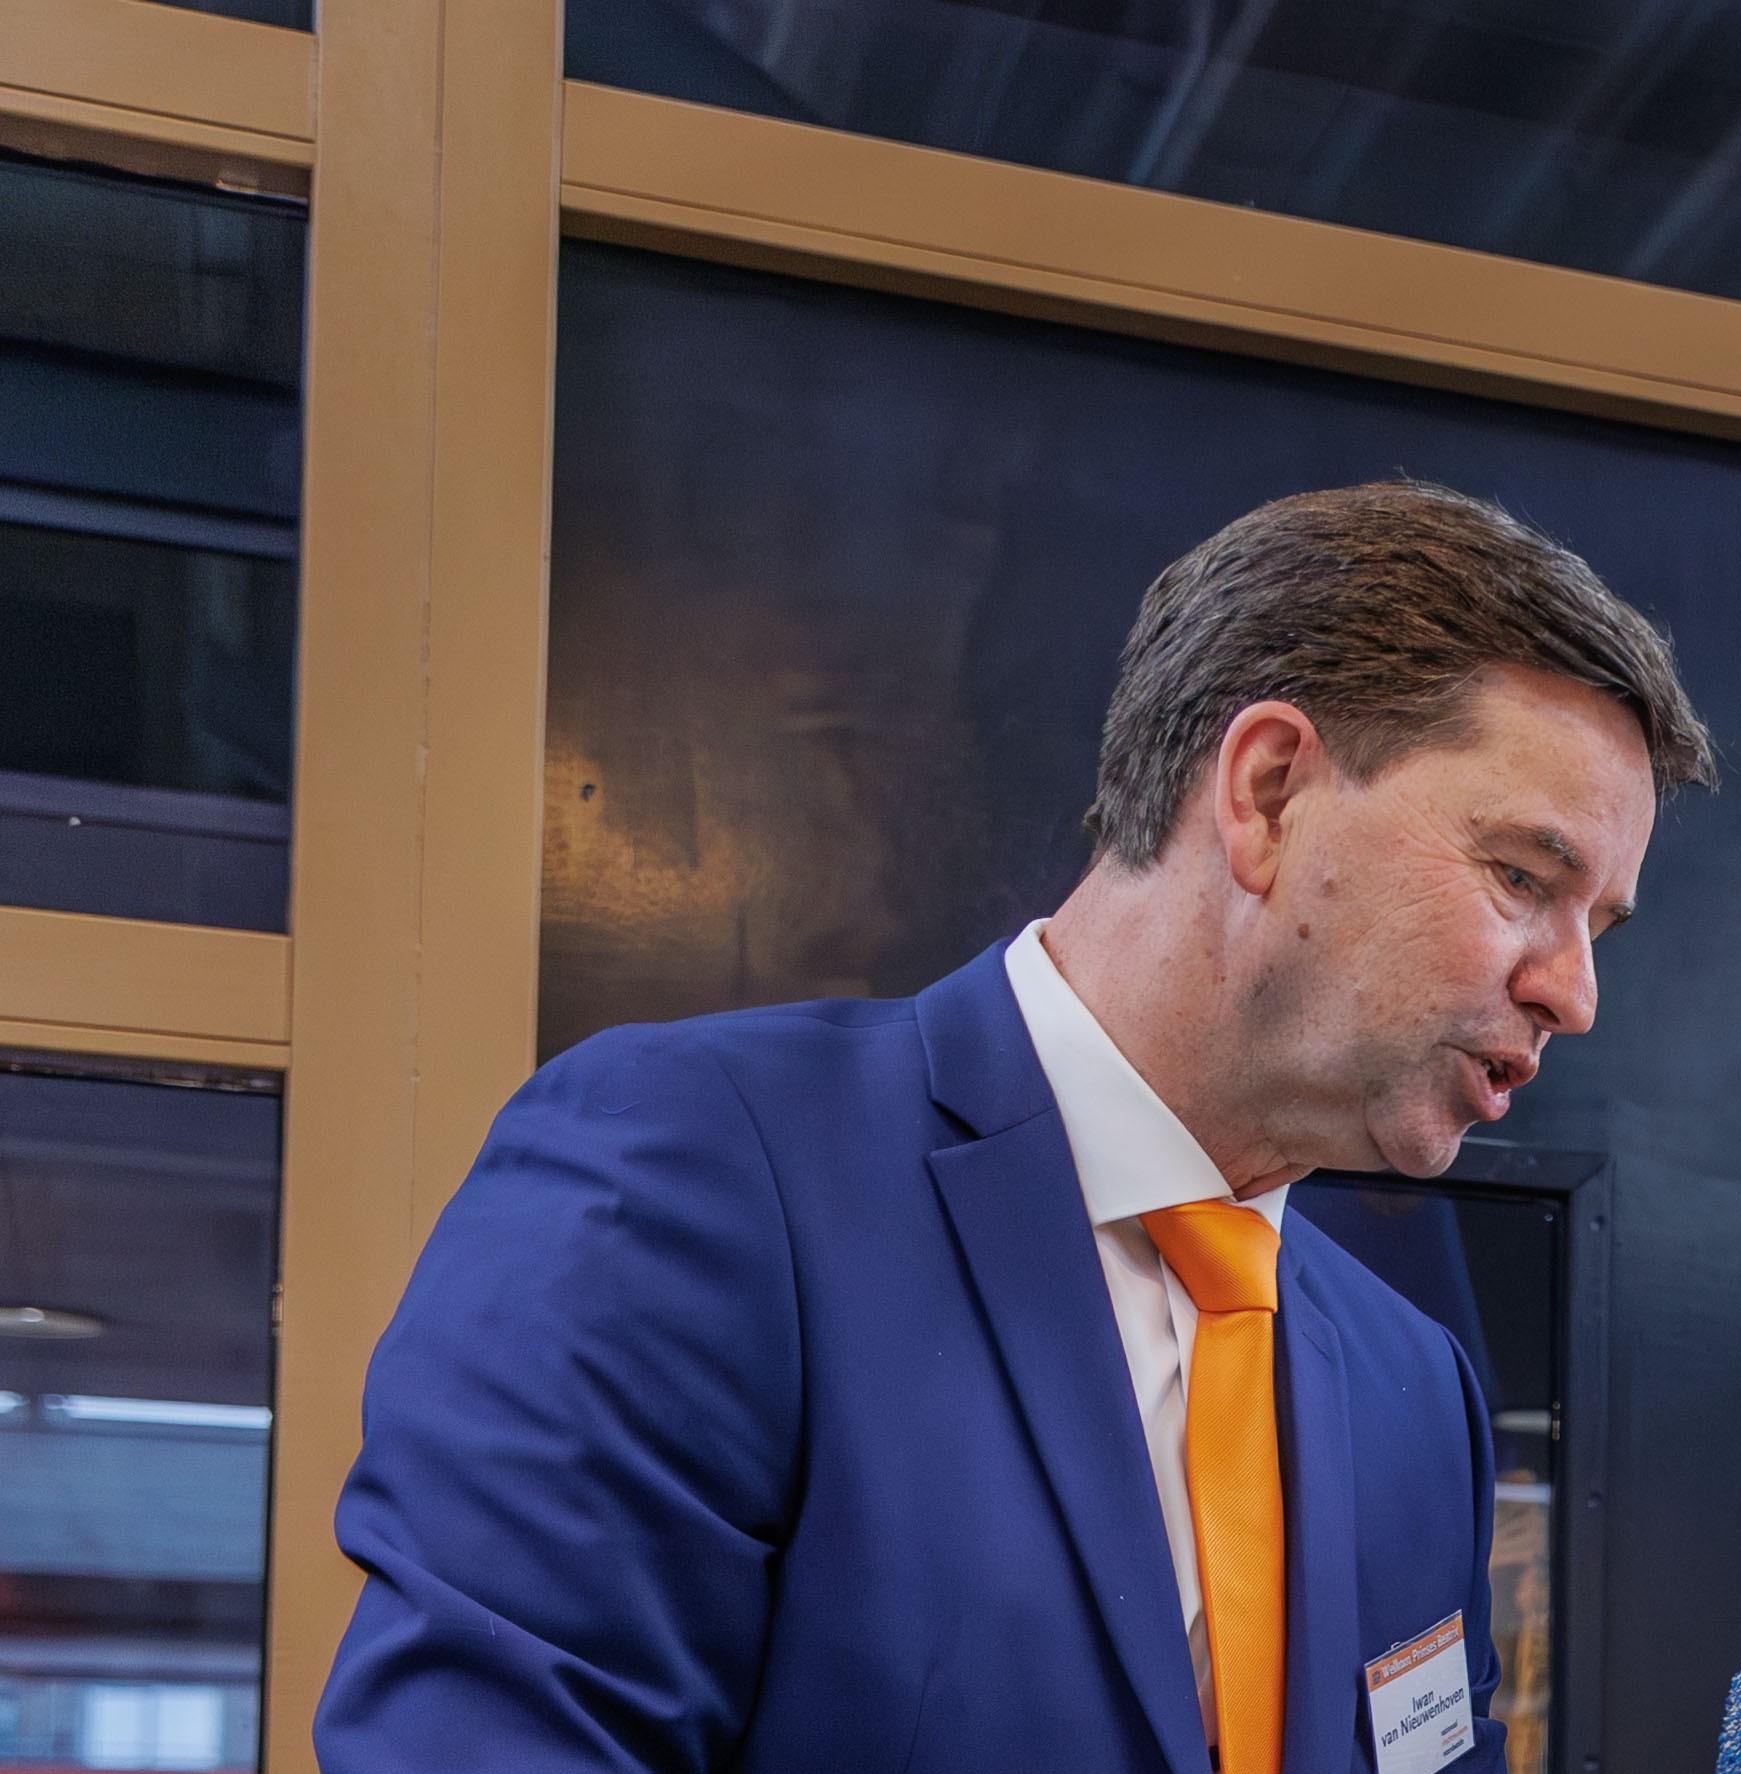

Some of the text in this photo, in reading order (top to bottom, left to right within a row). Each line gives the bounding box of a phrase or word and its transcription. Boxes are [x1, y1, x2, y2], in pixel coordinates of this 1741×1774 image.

[1382, 1656, 1412, 1679] Welkom
[1412, 1690, 1434, 1713] Iwan
[1381, 1727, 1399, 1748] van
[1400, 1687, 1465, 1737] Nieuwenhoven
